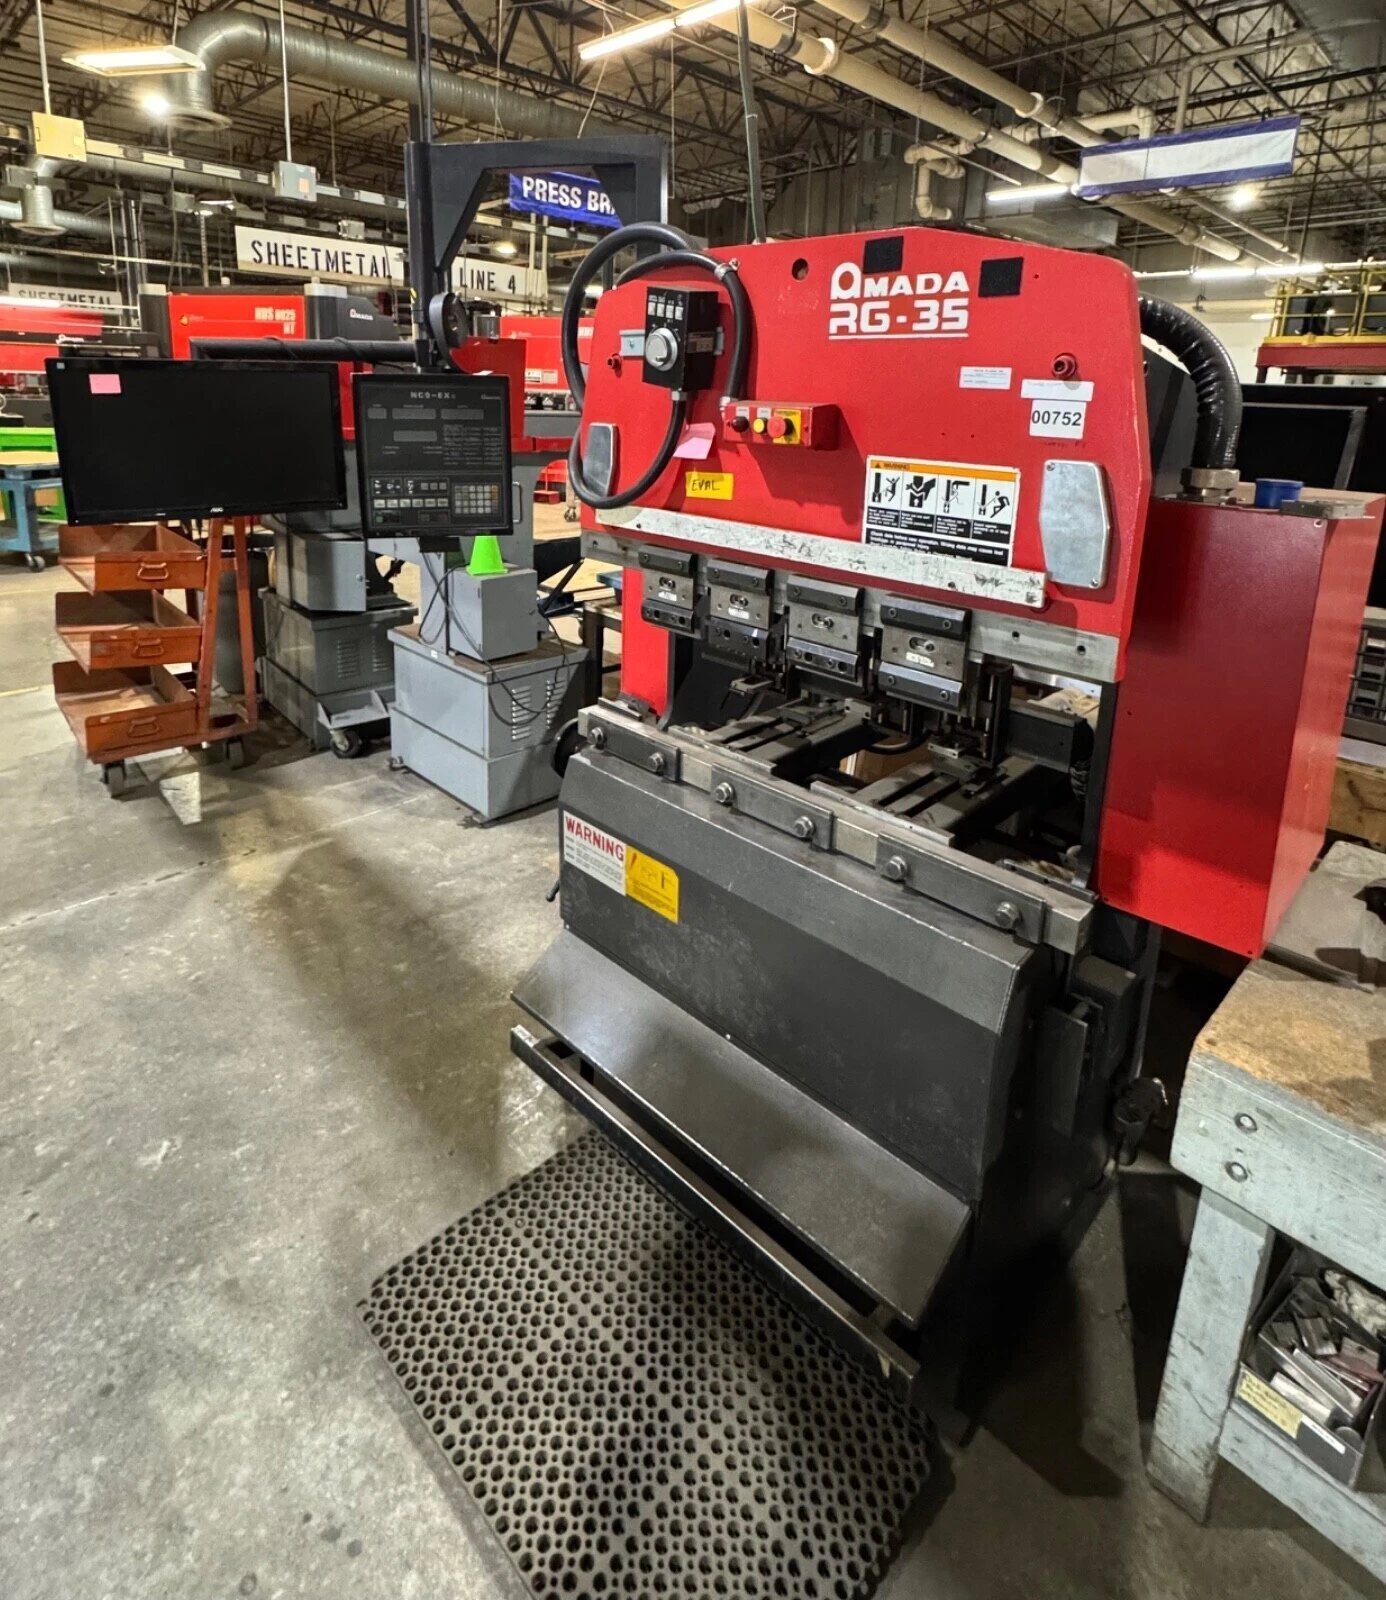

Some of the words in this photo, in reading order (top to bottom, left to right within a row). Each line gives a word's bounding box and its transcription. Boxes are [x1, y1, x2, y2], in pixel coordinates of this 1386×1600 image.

[522, 176, 582, 209] PRESS
[587, 190, 615, 215] BR
[251, 240, 392, 278] SHEETMETAL
[460, 267, 496, 292] LINE
[508, 274, 516, 295] 4
[830, 262, 970, 300] AMADA
[829, 298, 969, 334] RG-35
[1031, 410, 1082, 426] 00752
[691, 479, 720, 491] EVAL
[565, 816, 624, 861] WARNING
